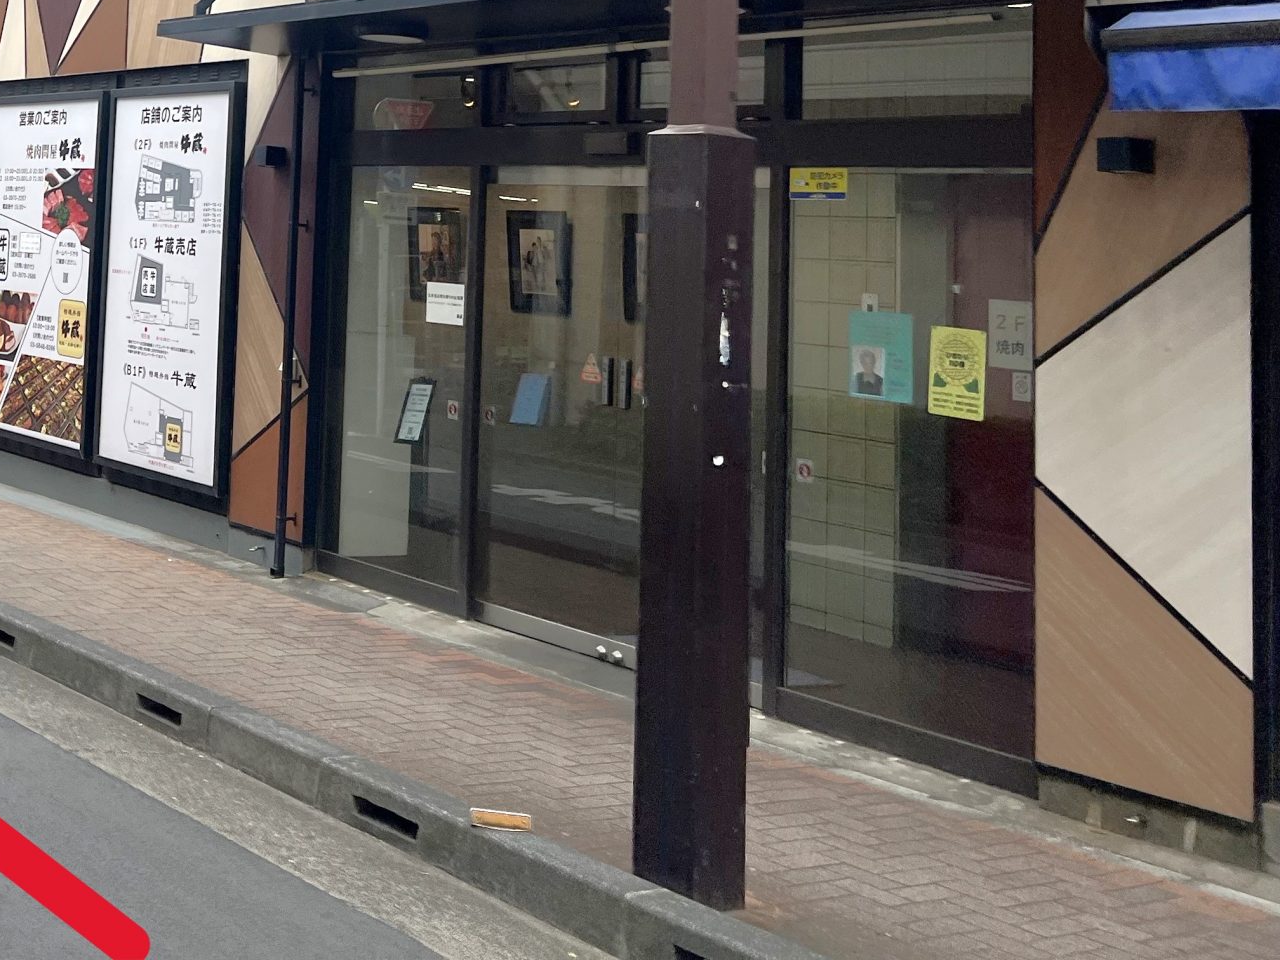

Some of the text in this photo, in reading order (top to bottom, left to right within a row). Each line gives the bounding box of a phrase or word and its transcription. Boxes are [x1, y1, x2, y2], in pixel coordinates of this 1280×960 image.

[19, 109, 68, 127] 営業のご案内
[141, 105, 203, 125] 店舗のご案内
[154, 236, 197, 256] 牛蔵売店
[995, 340, 1025, 356] 焼肉
[170, 370, 197, 389] 牛蔵
